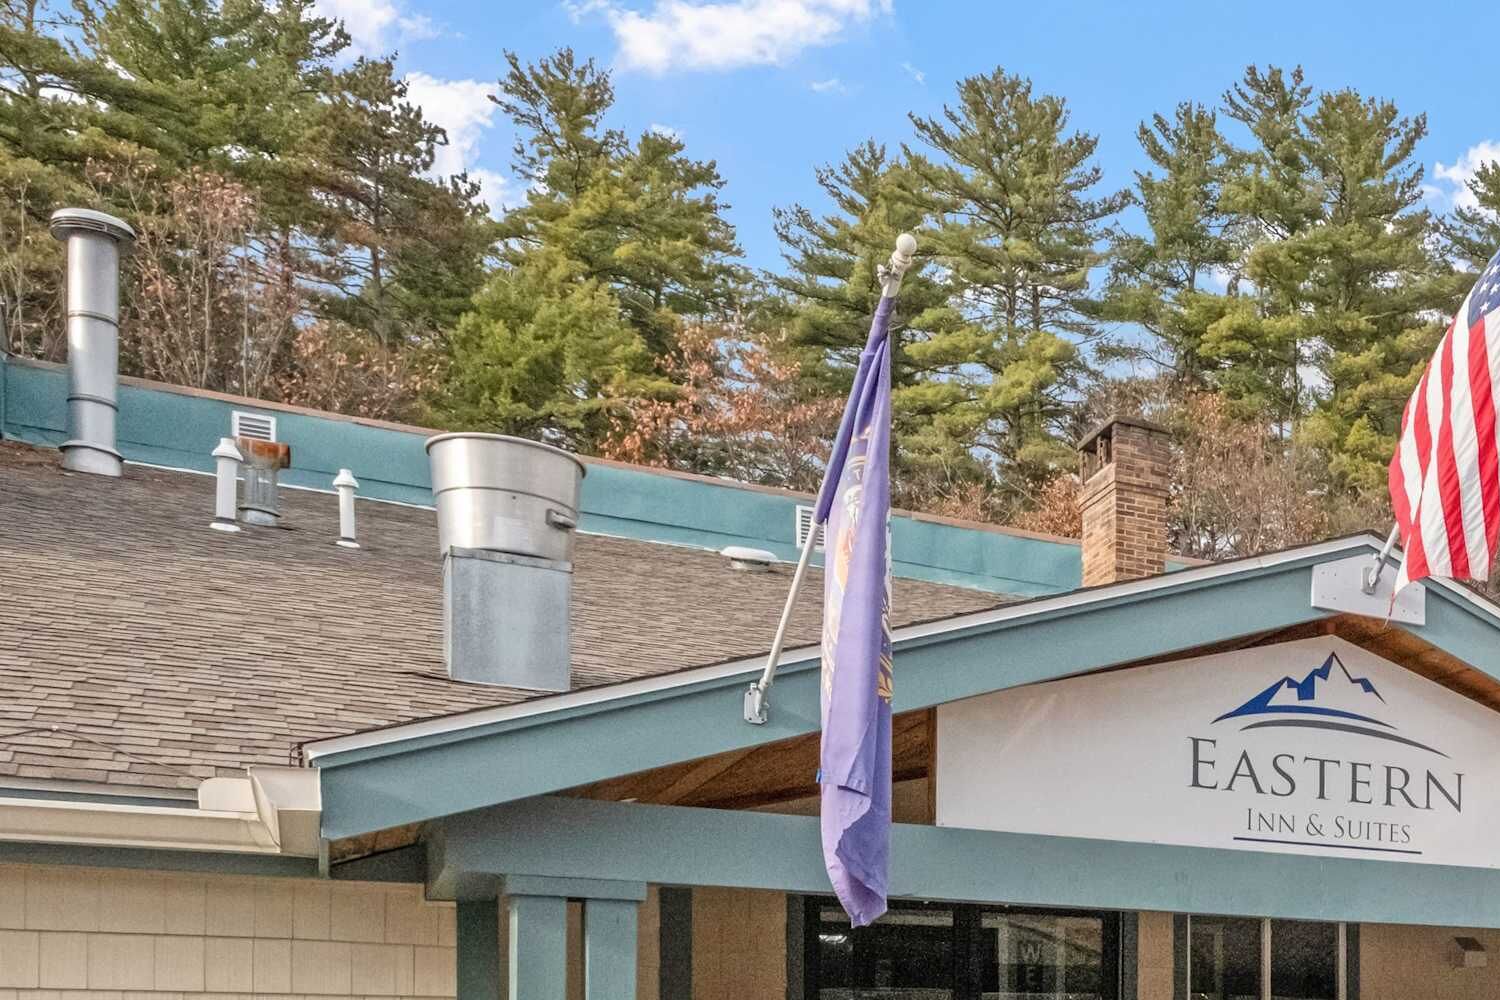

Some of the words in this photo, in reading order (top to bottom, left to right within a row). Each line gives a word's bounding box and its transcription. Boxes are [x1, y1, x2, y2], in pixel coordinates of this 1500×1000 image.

[1187, 735, 1465, 814] EASTERN
[1246, 807, 1296, 834] INN
[1305, 813, 1325, 837] &
[1333, 814, 1412, 844] SUITES
